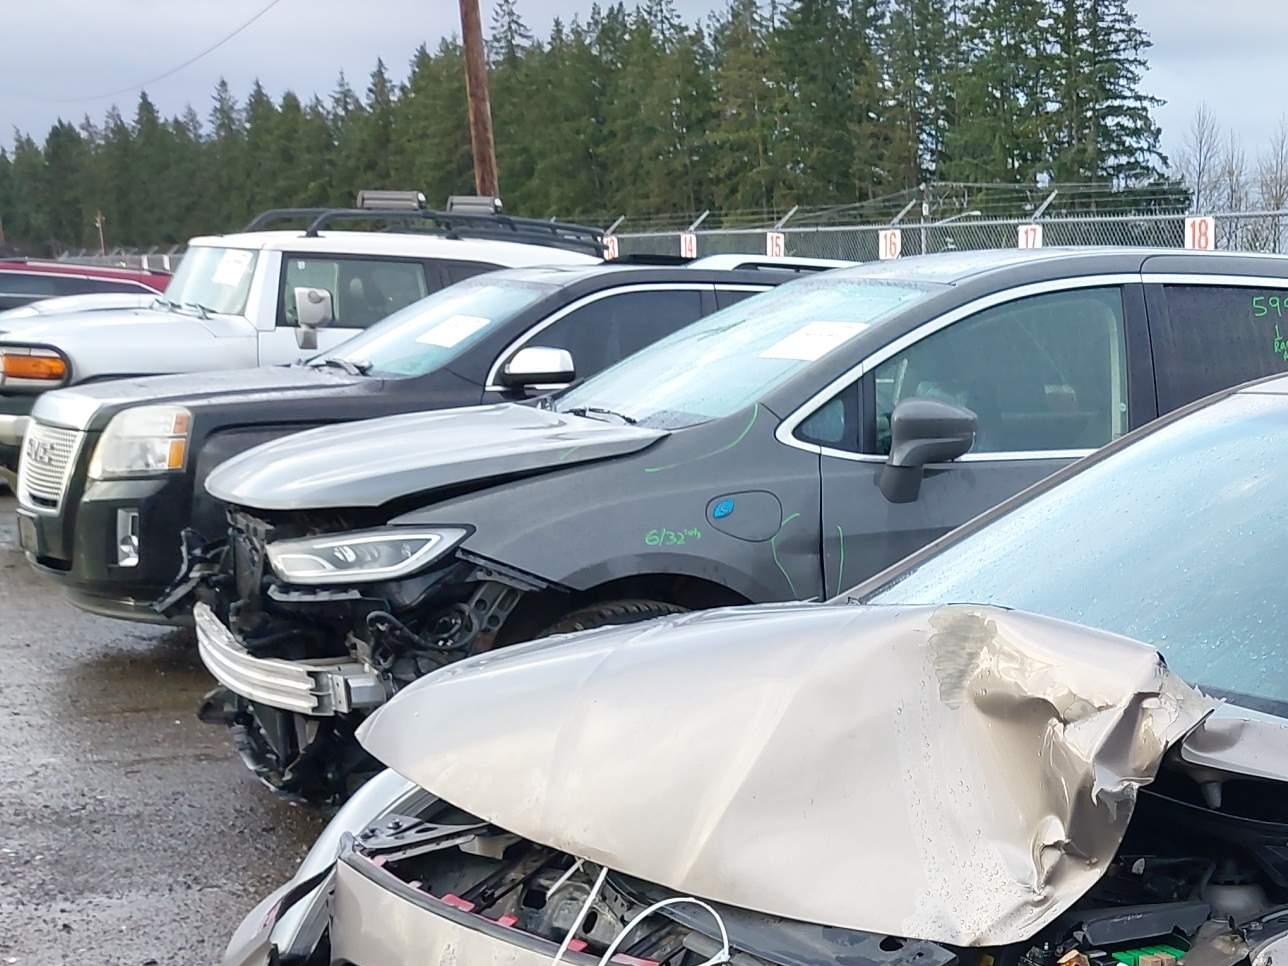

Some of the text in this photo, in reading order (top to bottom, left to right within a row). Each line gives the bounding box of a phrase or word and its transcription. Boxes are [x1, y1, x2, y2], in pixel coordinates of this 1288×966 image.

[883, 232, 897, 257] 16
[1024, 227, 1037, 249] 17
[1189, 219, 1209, 249] 18
[684, 235, 694, 258] 14
[770, 235, 782, 257] 15
